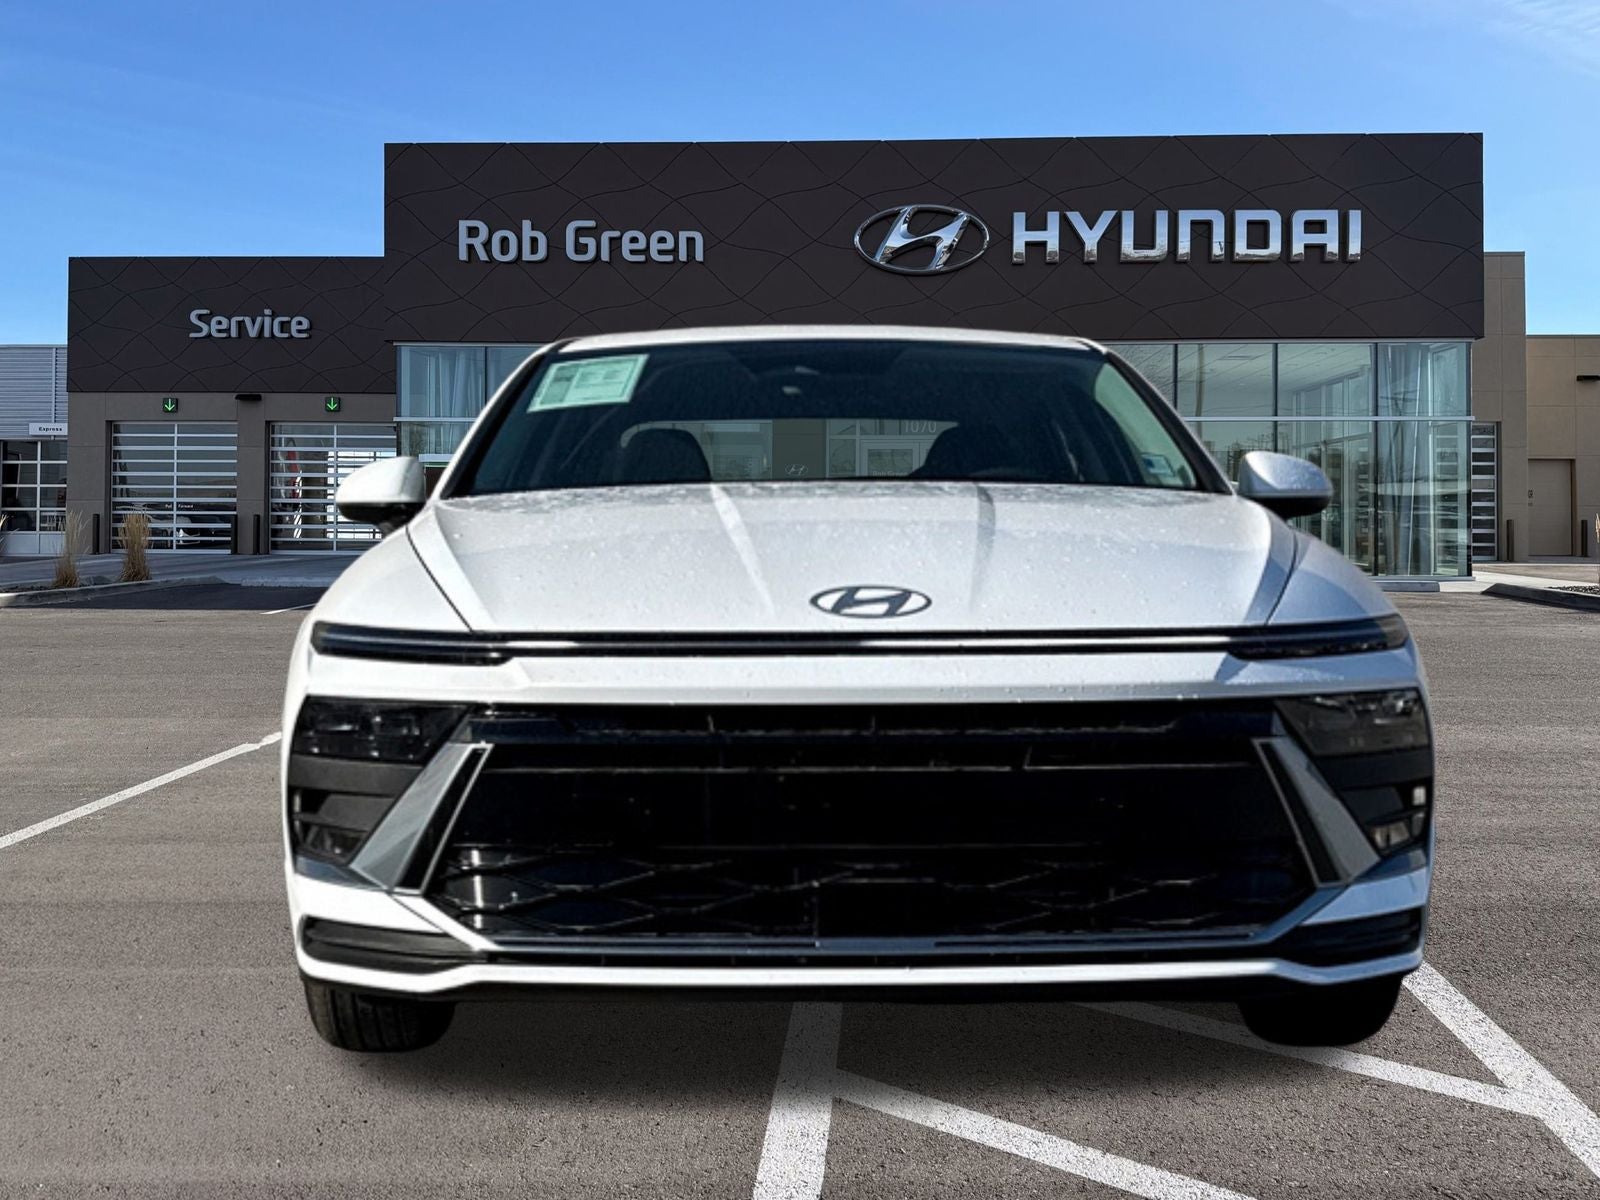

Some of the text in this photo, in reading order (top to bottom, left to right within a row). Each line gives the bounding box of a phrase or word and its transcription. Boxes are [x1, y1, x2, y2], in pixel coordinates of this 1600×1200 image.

[457, 219, 704, 263] Rob Green
[1011, 208, 1363, 265] HYUNDAI
[188, 307, 311, 339] Service
